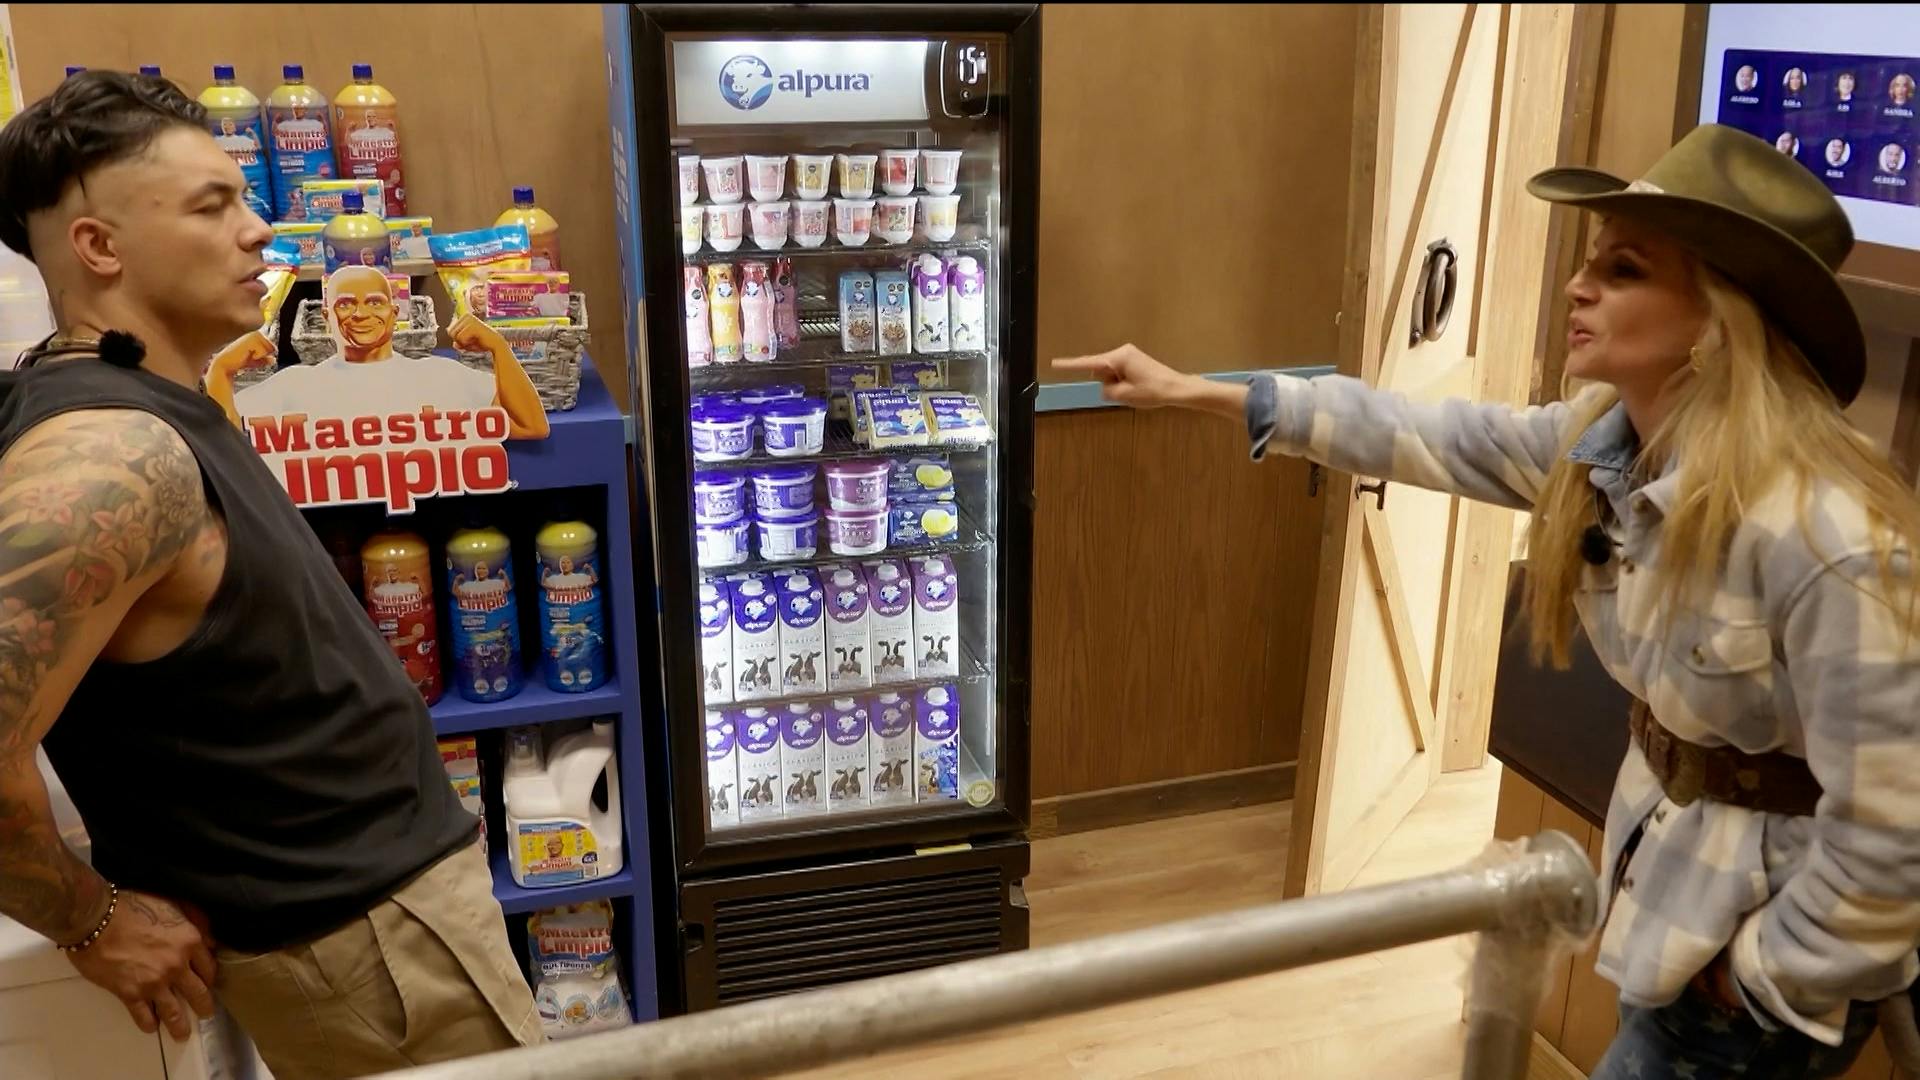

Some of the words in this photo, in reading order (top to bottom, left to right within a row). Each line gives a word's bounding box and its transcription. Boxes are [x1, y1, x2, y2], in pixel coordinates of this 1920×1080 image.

[778, 69, 870, 98] alpura
[248, 405, 506, 454] Maestro
[285, 444, 509, 510] impio
